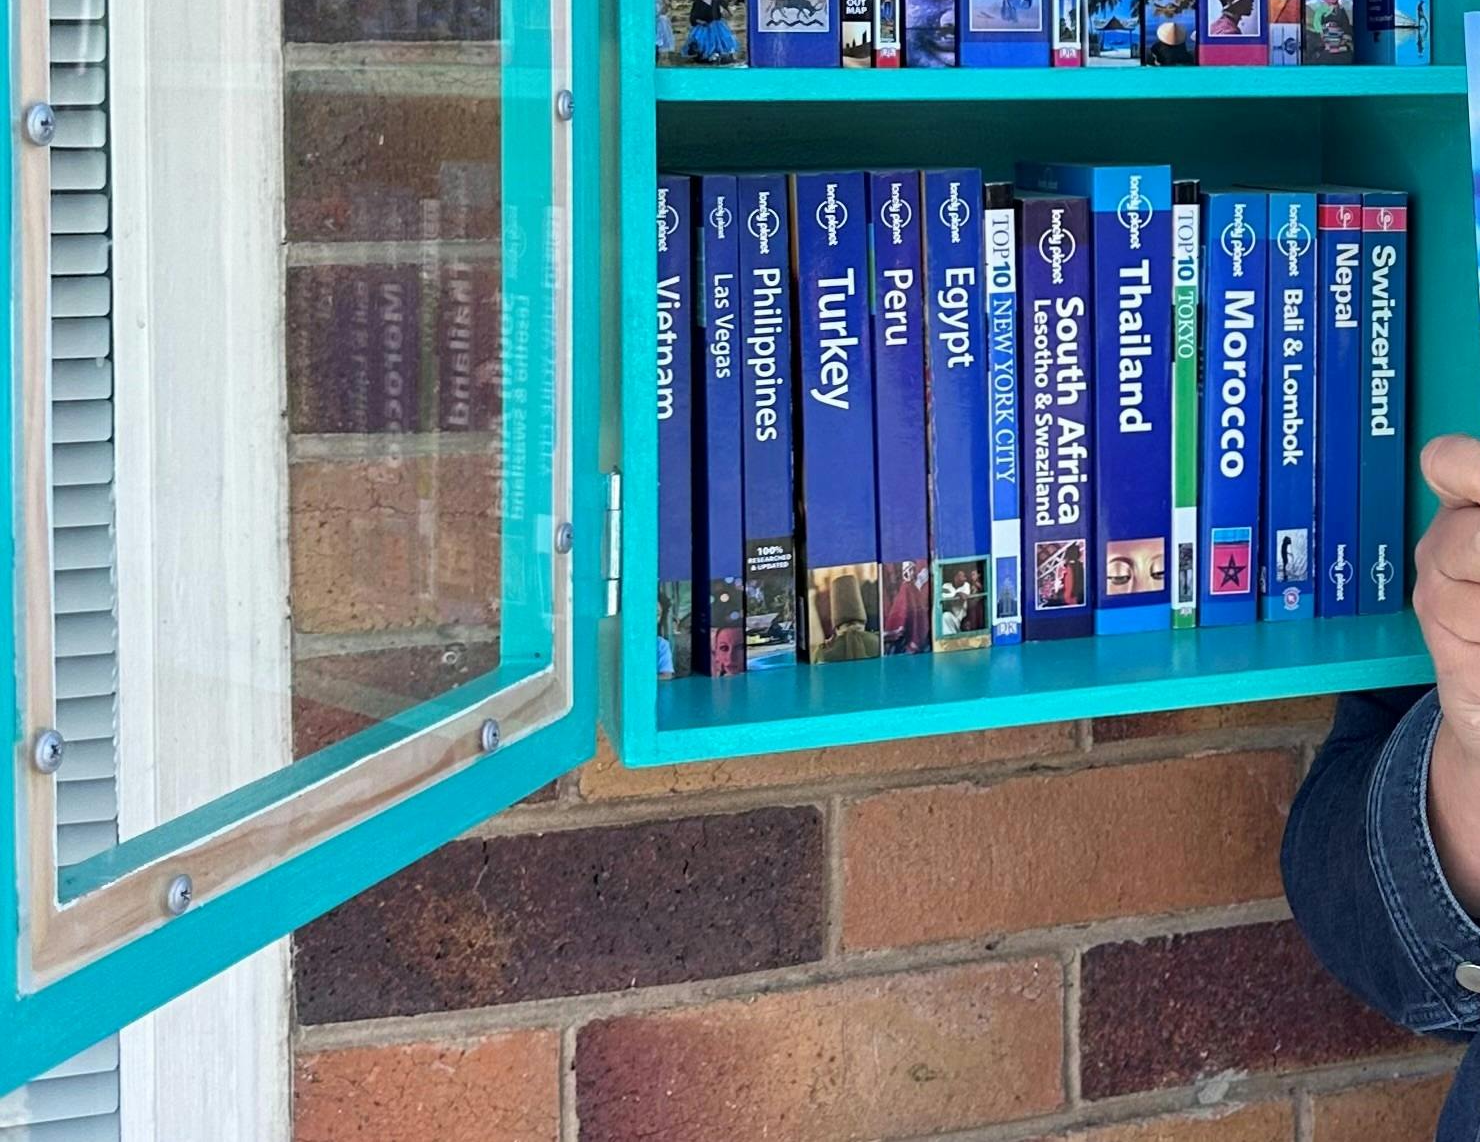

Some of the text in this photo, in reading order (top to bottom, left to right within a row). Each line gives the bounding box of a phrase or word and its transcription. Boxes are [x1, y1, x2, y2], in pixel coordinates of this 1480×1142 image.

[846, 0, 866, 7] OUT
[846, 7, 867, 15] MAP
[756, 191, 770, 254] lonely planet
[824, 183, 839, 246] lonely planet
[889, 183, 903, 245] lonely planet
[947, 182, 961, 244] lonely planet
[1048, 209, 1064, 285] lonely planet
[1127, 175, 1143, 250] lonely planet
[1230, 203, 1247, 277] lonely planet
[1286, 203, 1301, 277] lonely planet
[883, 268, 914, 347] Peru
[937, 266, 976, 369] Egypt
[1177, 290, 1196, 359] TOKYO
[1330, 243, 1361, 329] Nepal
[656, 275, 681, 420] Vietnam
[710, 273, 735, 378] Las Vegas
[748, 267, 783, 443] Philippines
[810, 267, 859, 410] Turkey
[1119, 260, 1152, 433] Thailand
[1371, 245, 1397, 436] Switzerland
[993, 298, 1015, 483] NEW YORK CITY
[1034, 298, 1053, 527] Lesotho & Swaziland
[1055, 296, 1088, 526] South Africa
[1219, 290, 1256, 479] Morocco
[1282, 289, 1304, 467] Bali & Lombok
[757, 546, 784, 556] 100%
[1334, 544, 1347, 601] lonely planet
[1375, 544, 1388, 601] lonely planet
